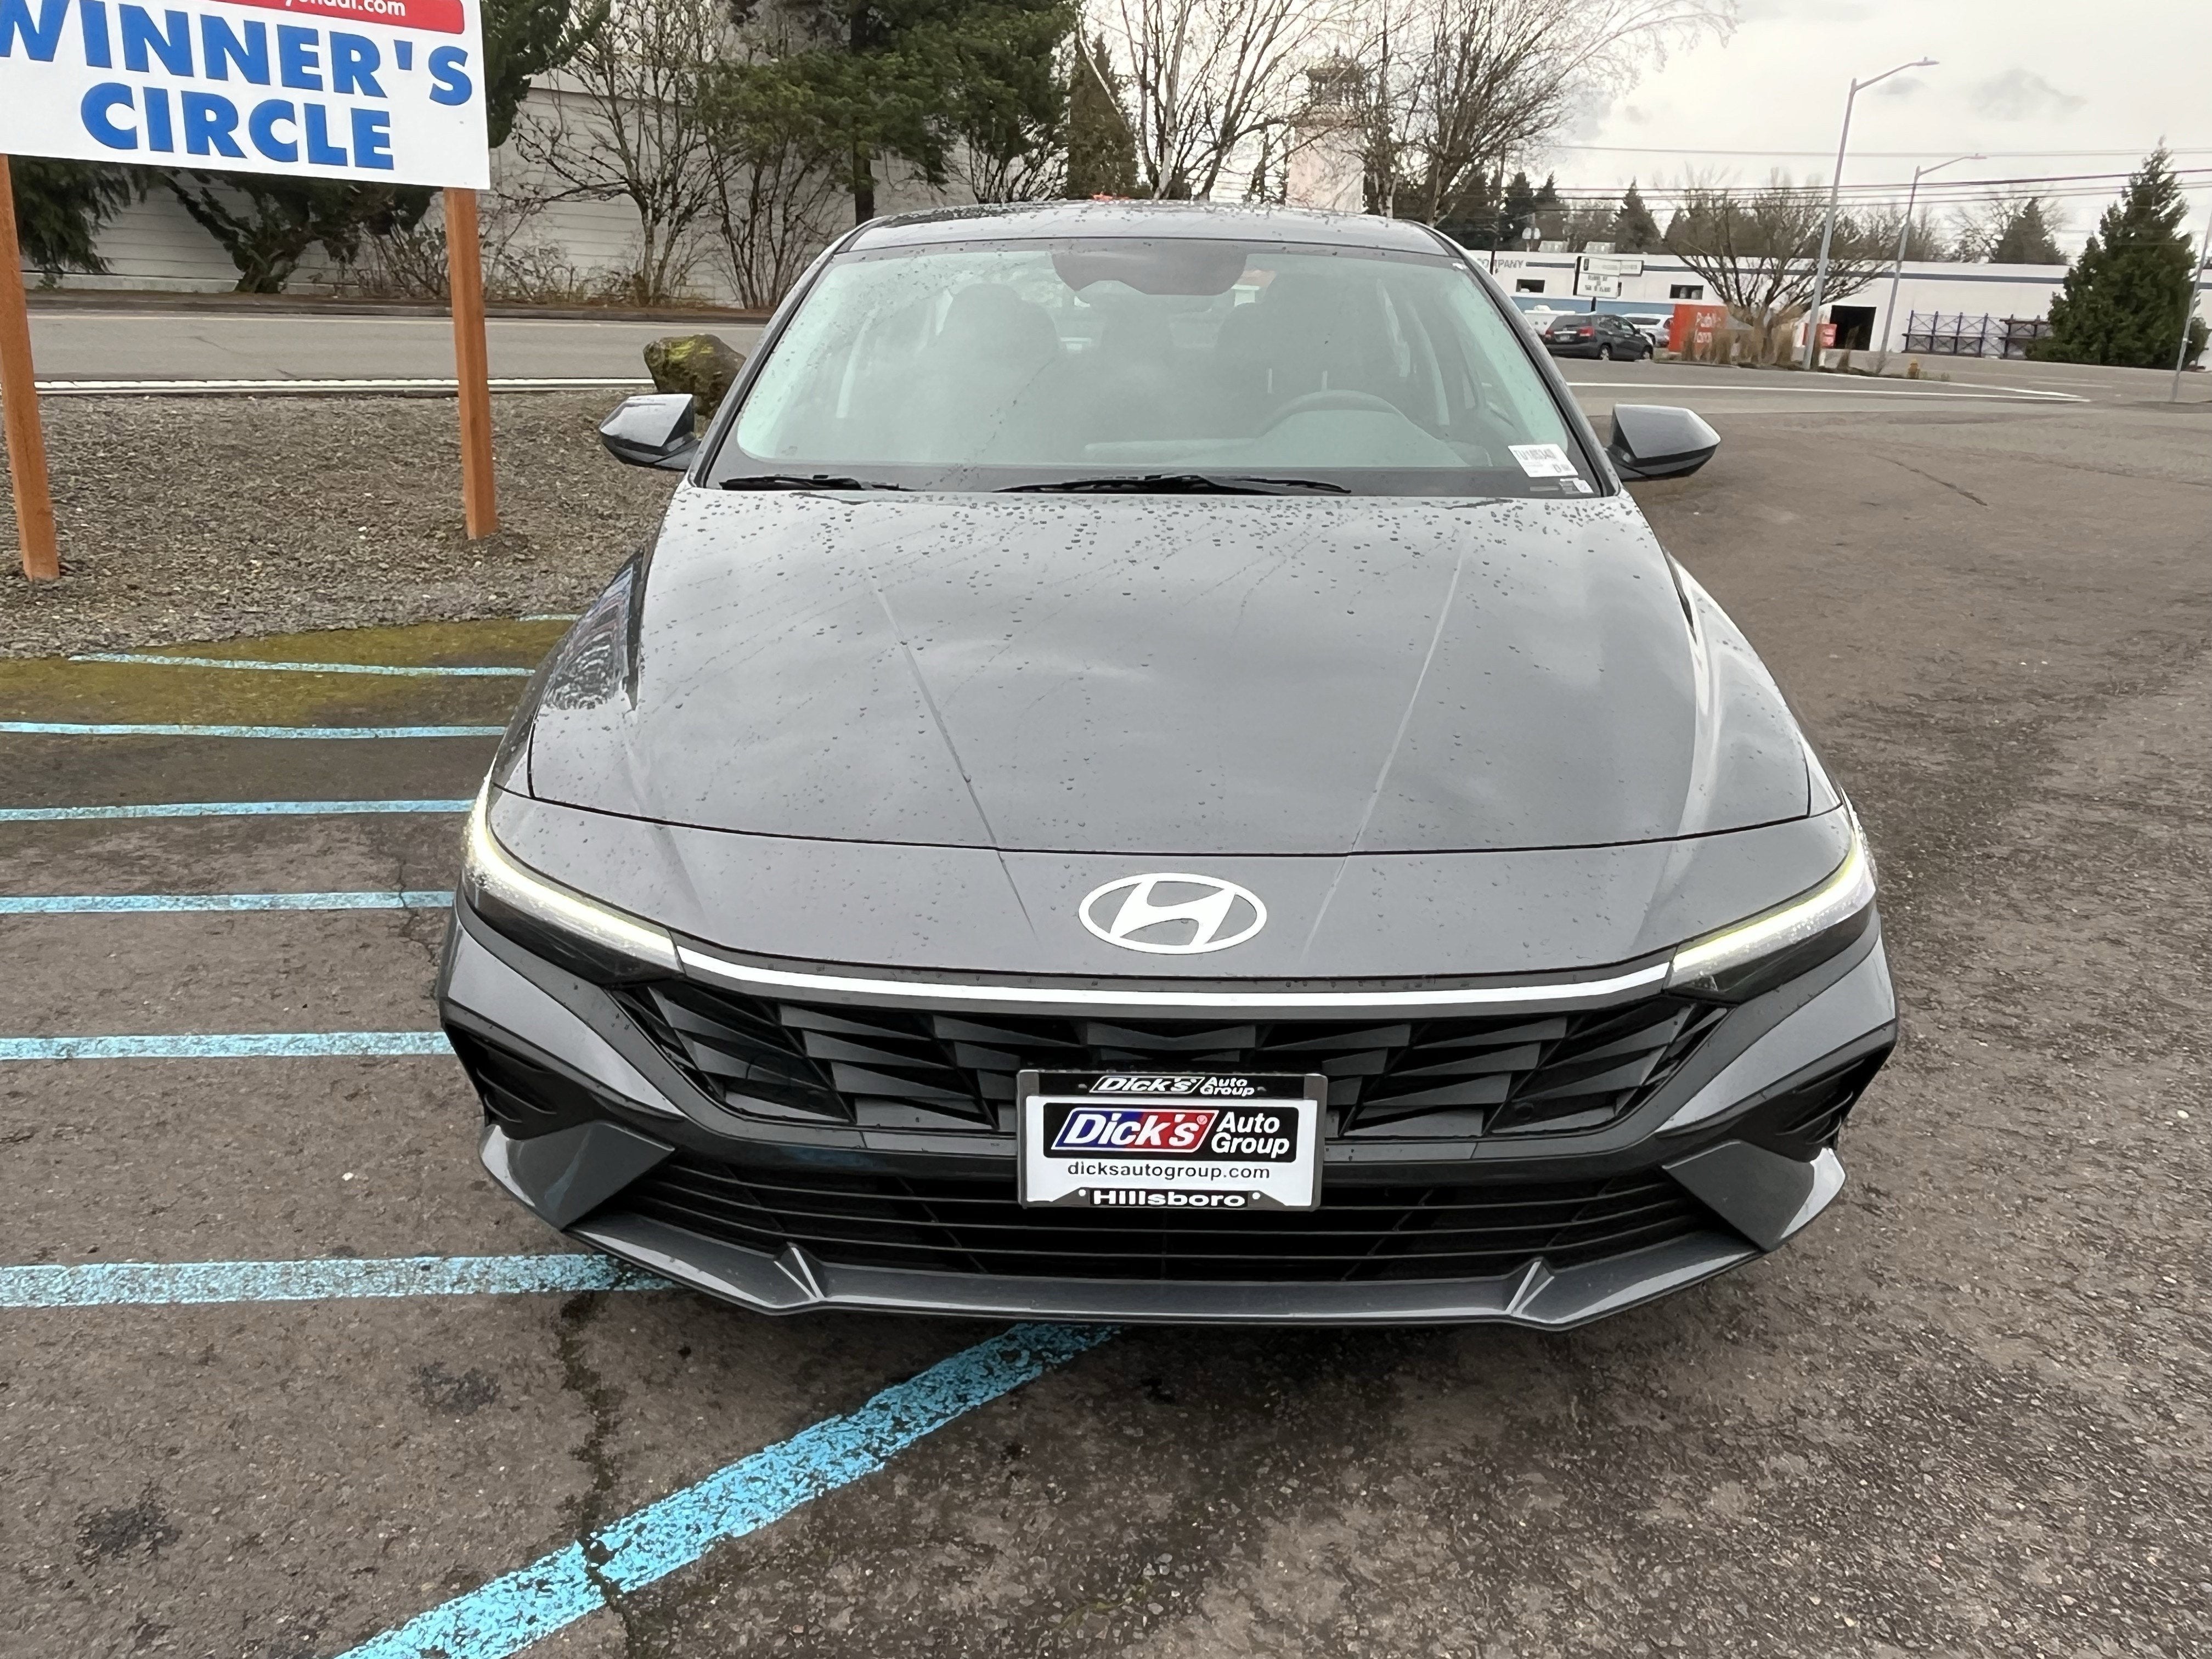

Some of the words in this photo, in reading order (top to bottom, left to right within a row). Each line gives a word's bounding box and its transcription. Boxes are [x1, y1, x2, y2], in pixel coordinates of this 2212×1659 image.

[0, 0, 472, 106] WINNER'S
[81, 83, 394, 170] CIRCLE
[1097, 1077, 1194, 1091] Dick's
[1200, 1086, 1254, 1096] Group
[1207, 1077, 1248, 1086] Auto
[1063, 1113, 1200, 1146] Dick's
[1217, 1111, 1280, 1133] Auto
[1211, 1132, 1289, 1158] Group
[1068, 1161, 1269, 1181] dicksautogroup.com
[1093, 1190, 1245, 1206] Hillsboro
